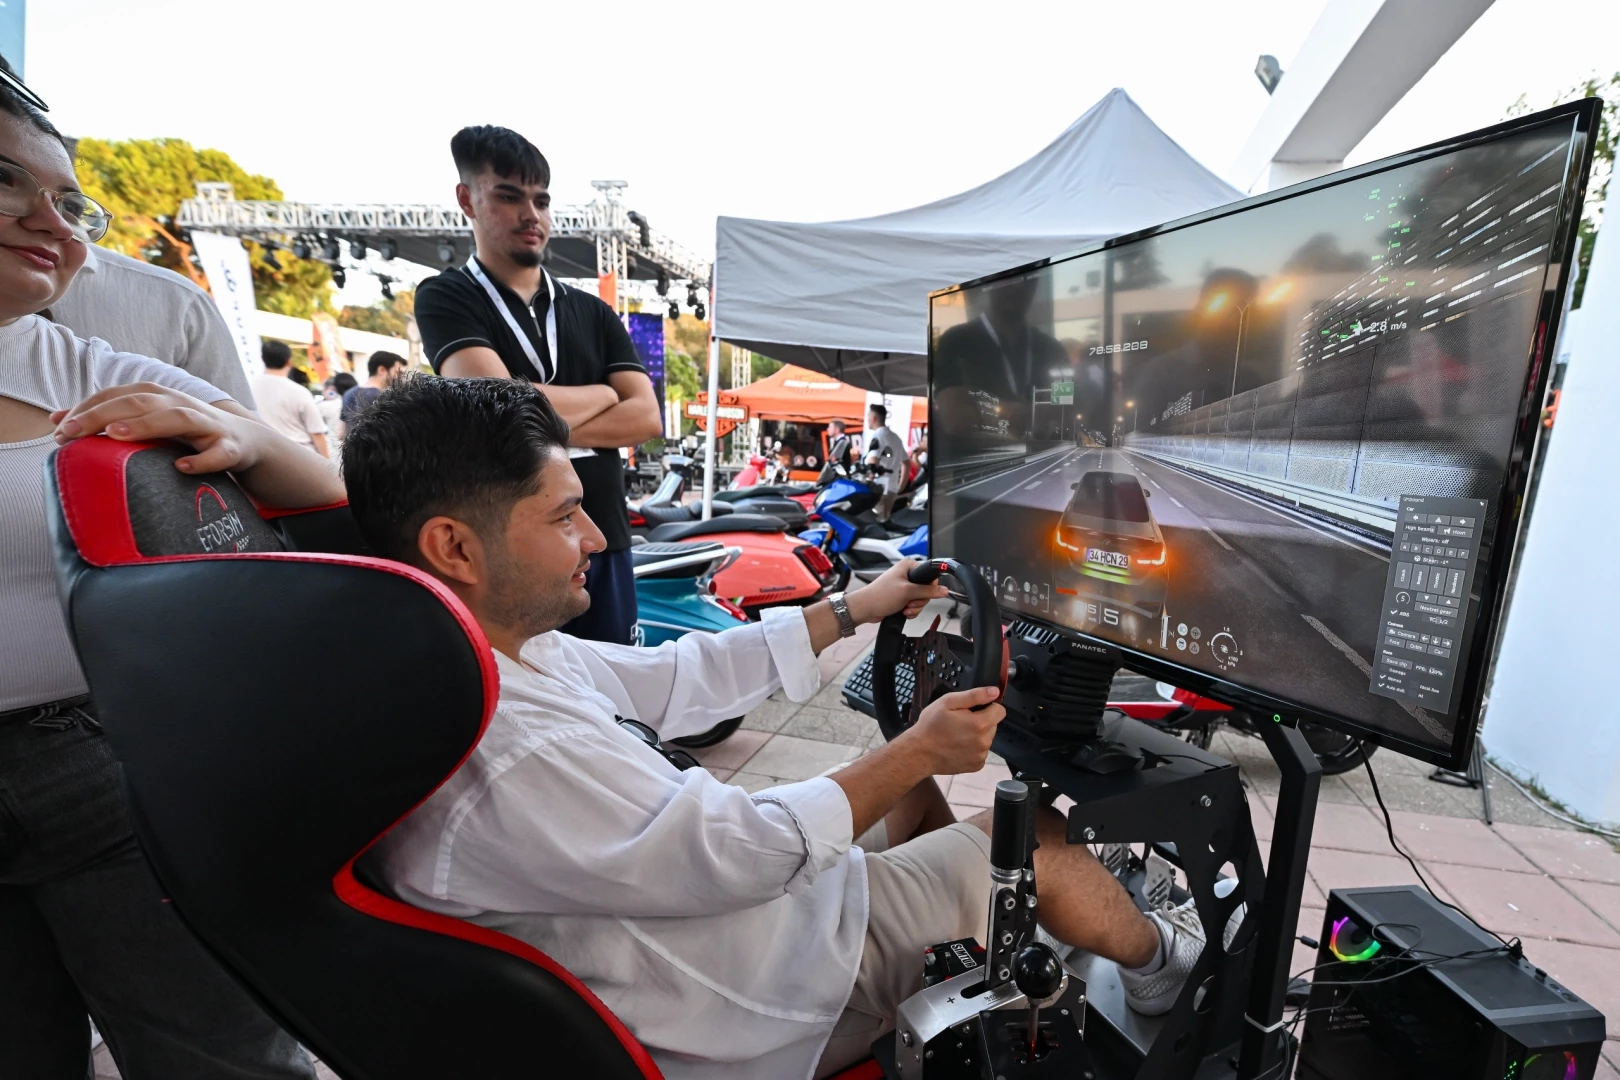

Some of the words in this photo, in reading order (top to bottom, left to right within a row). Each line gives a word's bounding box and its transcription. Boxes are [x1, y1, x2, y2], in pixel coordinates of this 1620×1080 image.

[1370, 321, 1387, 332] 2.8
[1390, 322, 1407, 330] m/s
[1090, 550, 1098, 560] 34
[1101, 552, 1117, 564] HCN
[1119, 556, 1128, 567] 29
[1104, 608, 1119, 626] 5
[1072, 642, 1106, 654] FANATEC
